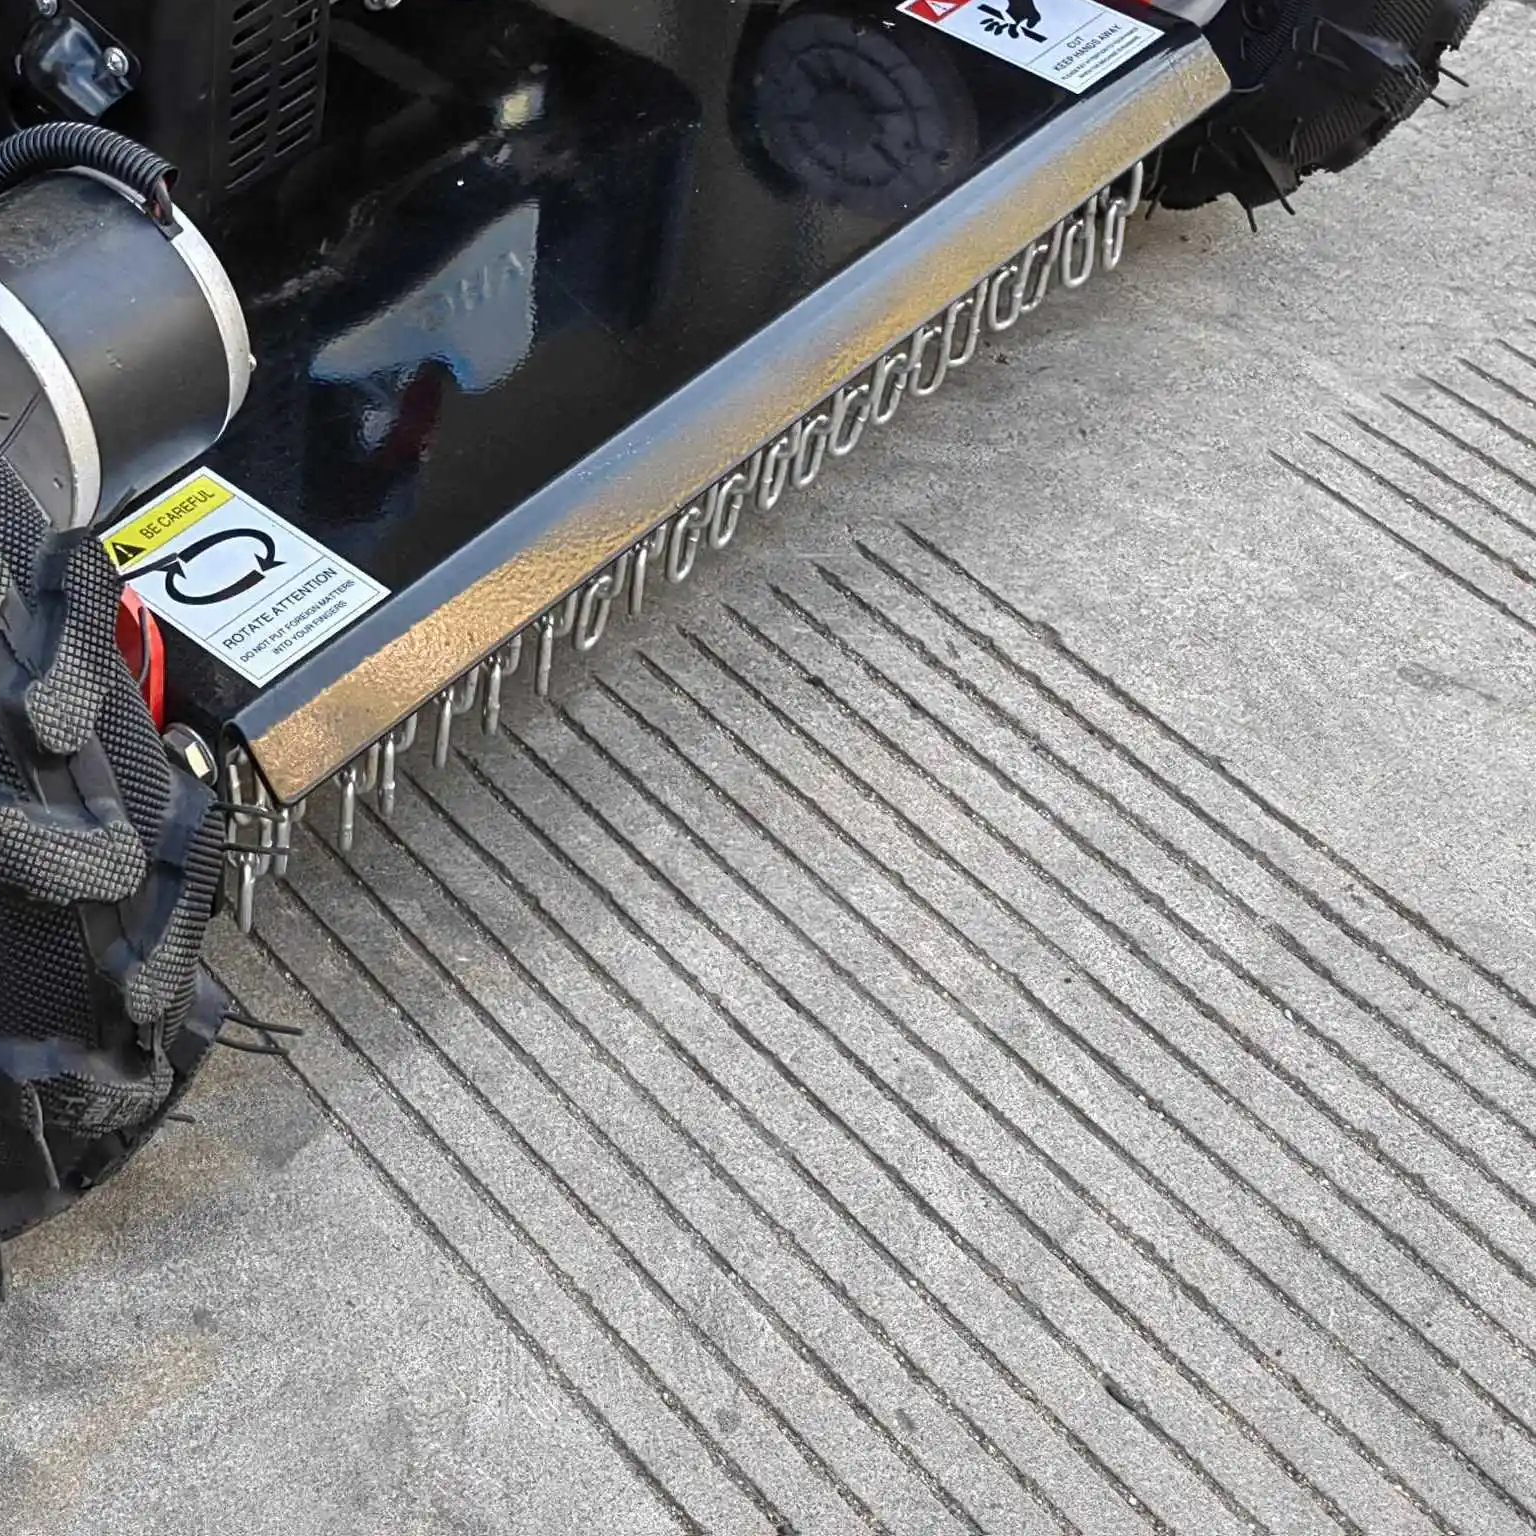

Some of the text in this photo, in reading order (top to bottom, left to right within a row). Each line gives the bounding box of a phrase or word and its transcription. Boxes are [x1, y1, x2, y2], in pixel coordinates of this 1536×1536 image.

[1053, 56, 1074, 72] KEEP
[1073, 38, 1101, 58] HANDS
[1098, 23, 1121, 41] AWAY
[140, 488, 217, 541] BE CAREFUL
[222, 567, 339, 650] ROTATE ATTENTION
[239, 579, 356, 663] DO NOT PUT FOREIGN MATTERS
[272, 599, 348, 656] INTO YOUR FINGERS
